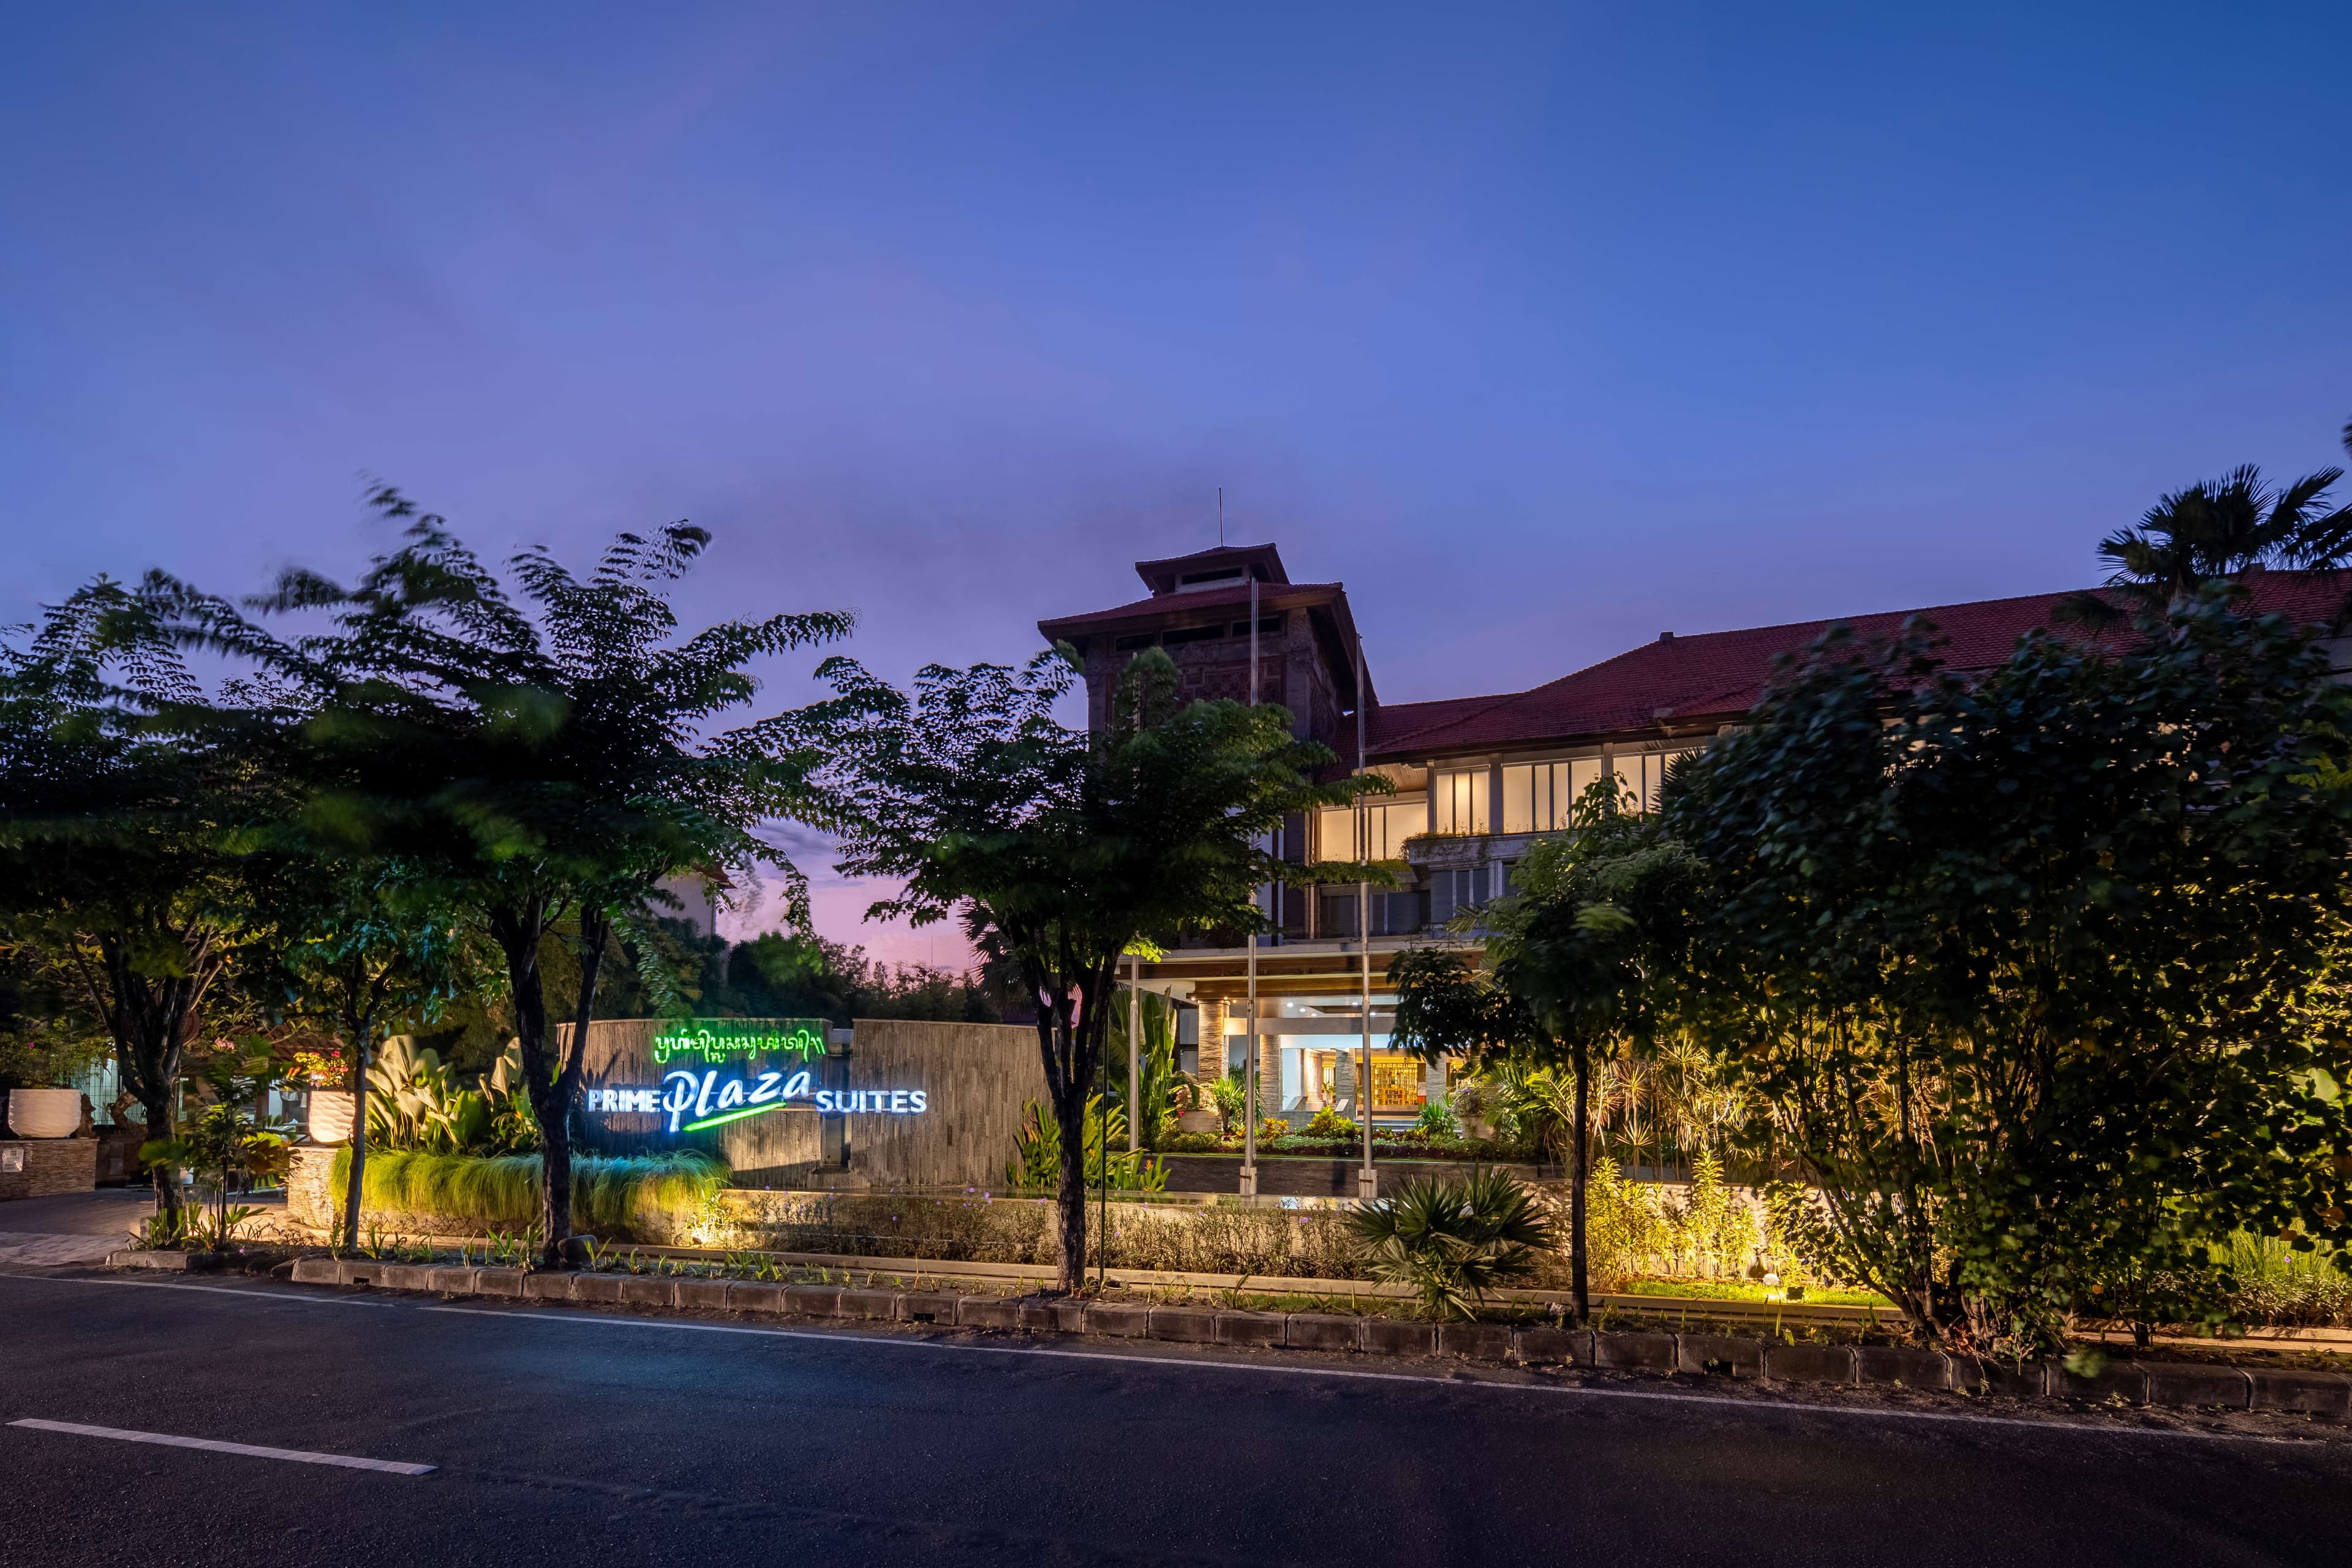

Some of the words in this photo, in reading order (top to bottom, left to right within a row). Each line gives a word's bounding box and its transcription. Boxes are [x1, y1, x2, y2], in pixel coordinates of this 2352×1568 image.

[588, 1089, 661, 1112] PRIME
[662, 1070, 810, 1133] Plaza
[815, 1090, 927, 1114] SUITES
